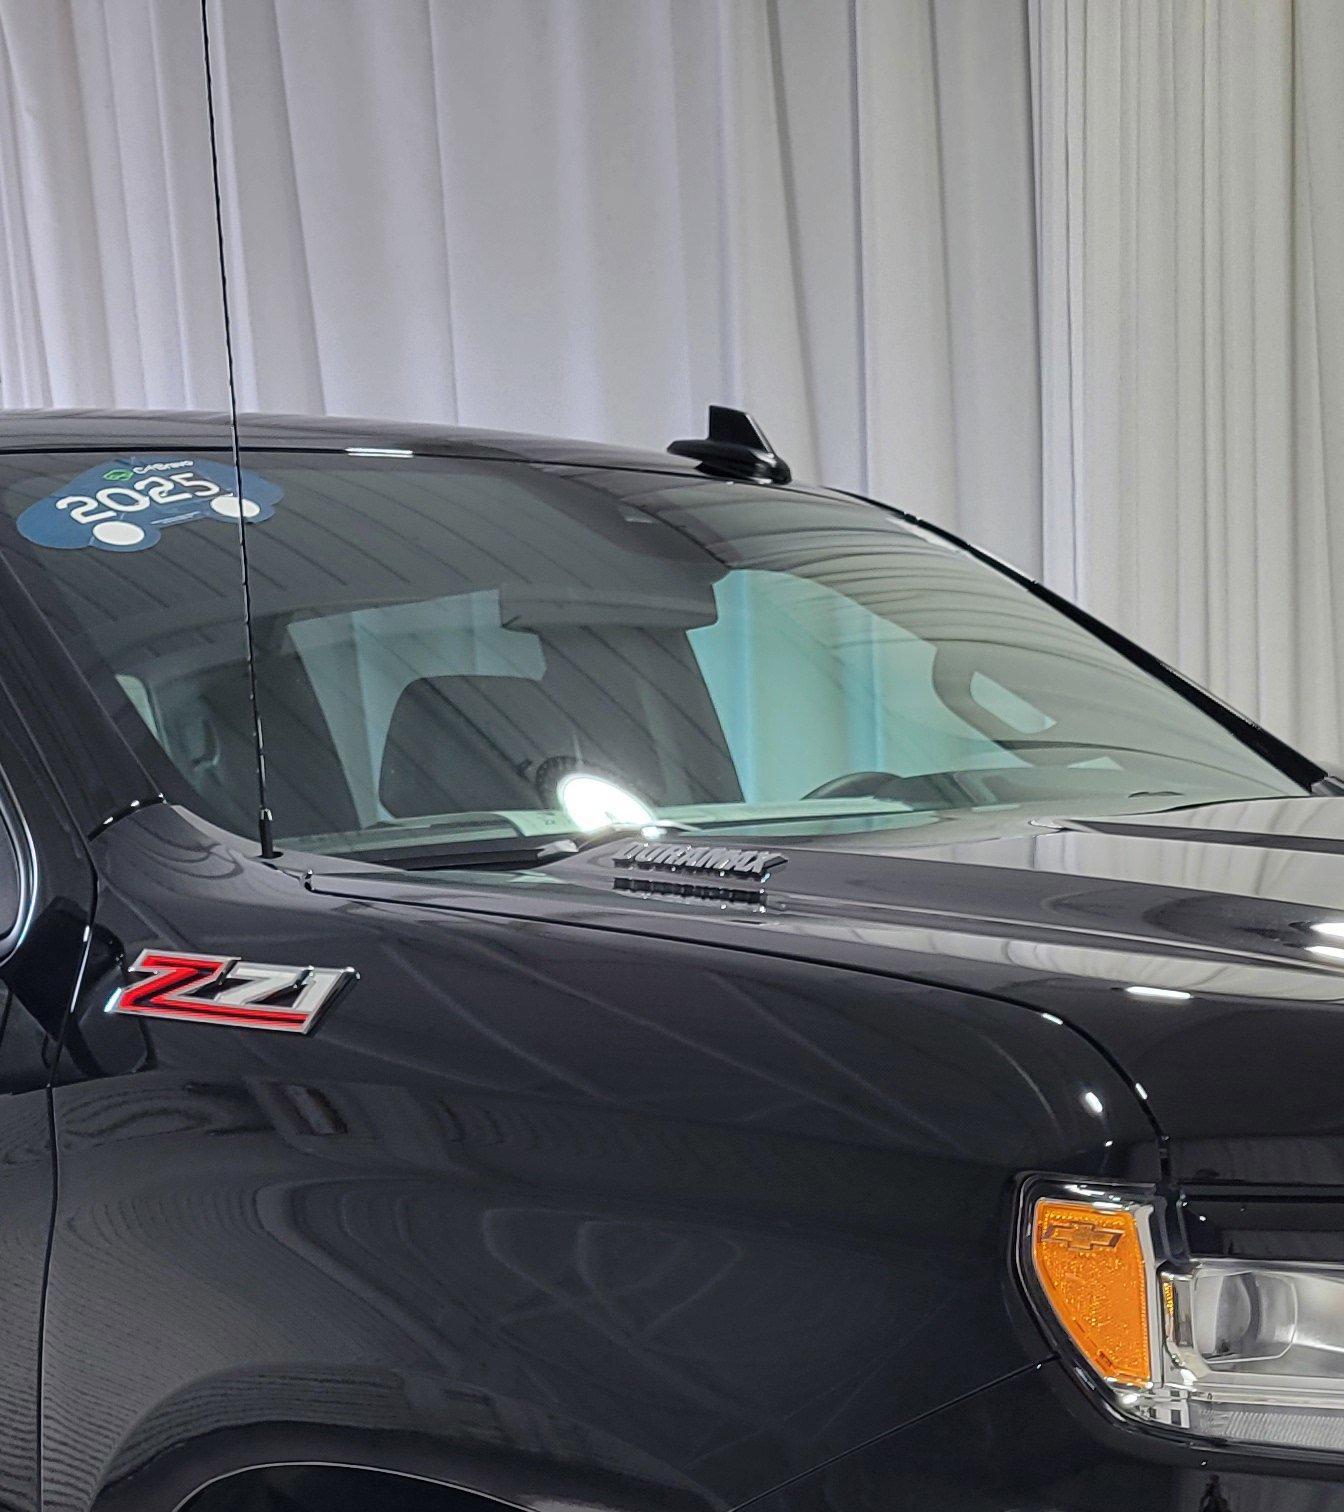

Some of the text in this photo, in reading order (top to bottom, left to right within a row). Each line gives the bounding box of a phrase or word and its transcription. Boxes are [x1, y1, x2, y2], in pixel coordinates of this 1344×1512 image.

[55, 472, 221, 525] 2025
[612, 841, 786, 880] DURAMAX
[105, 948, 357, 1036] Z71
